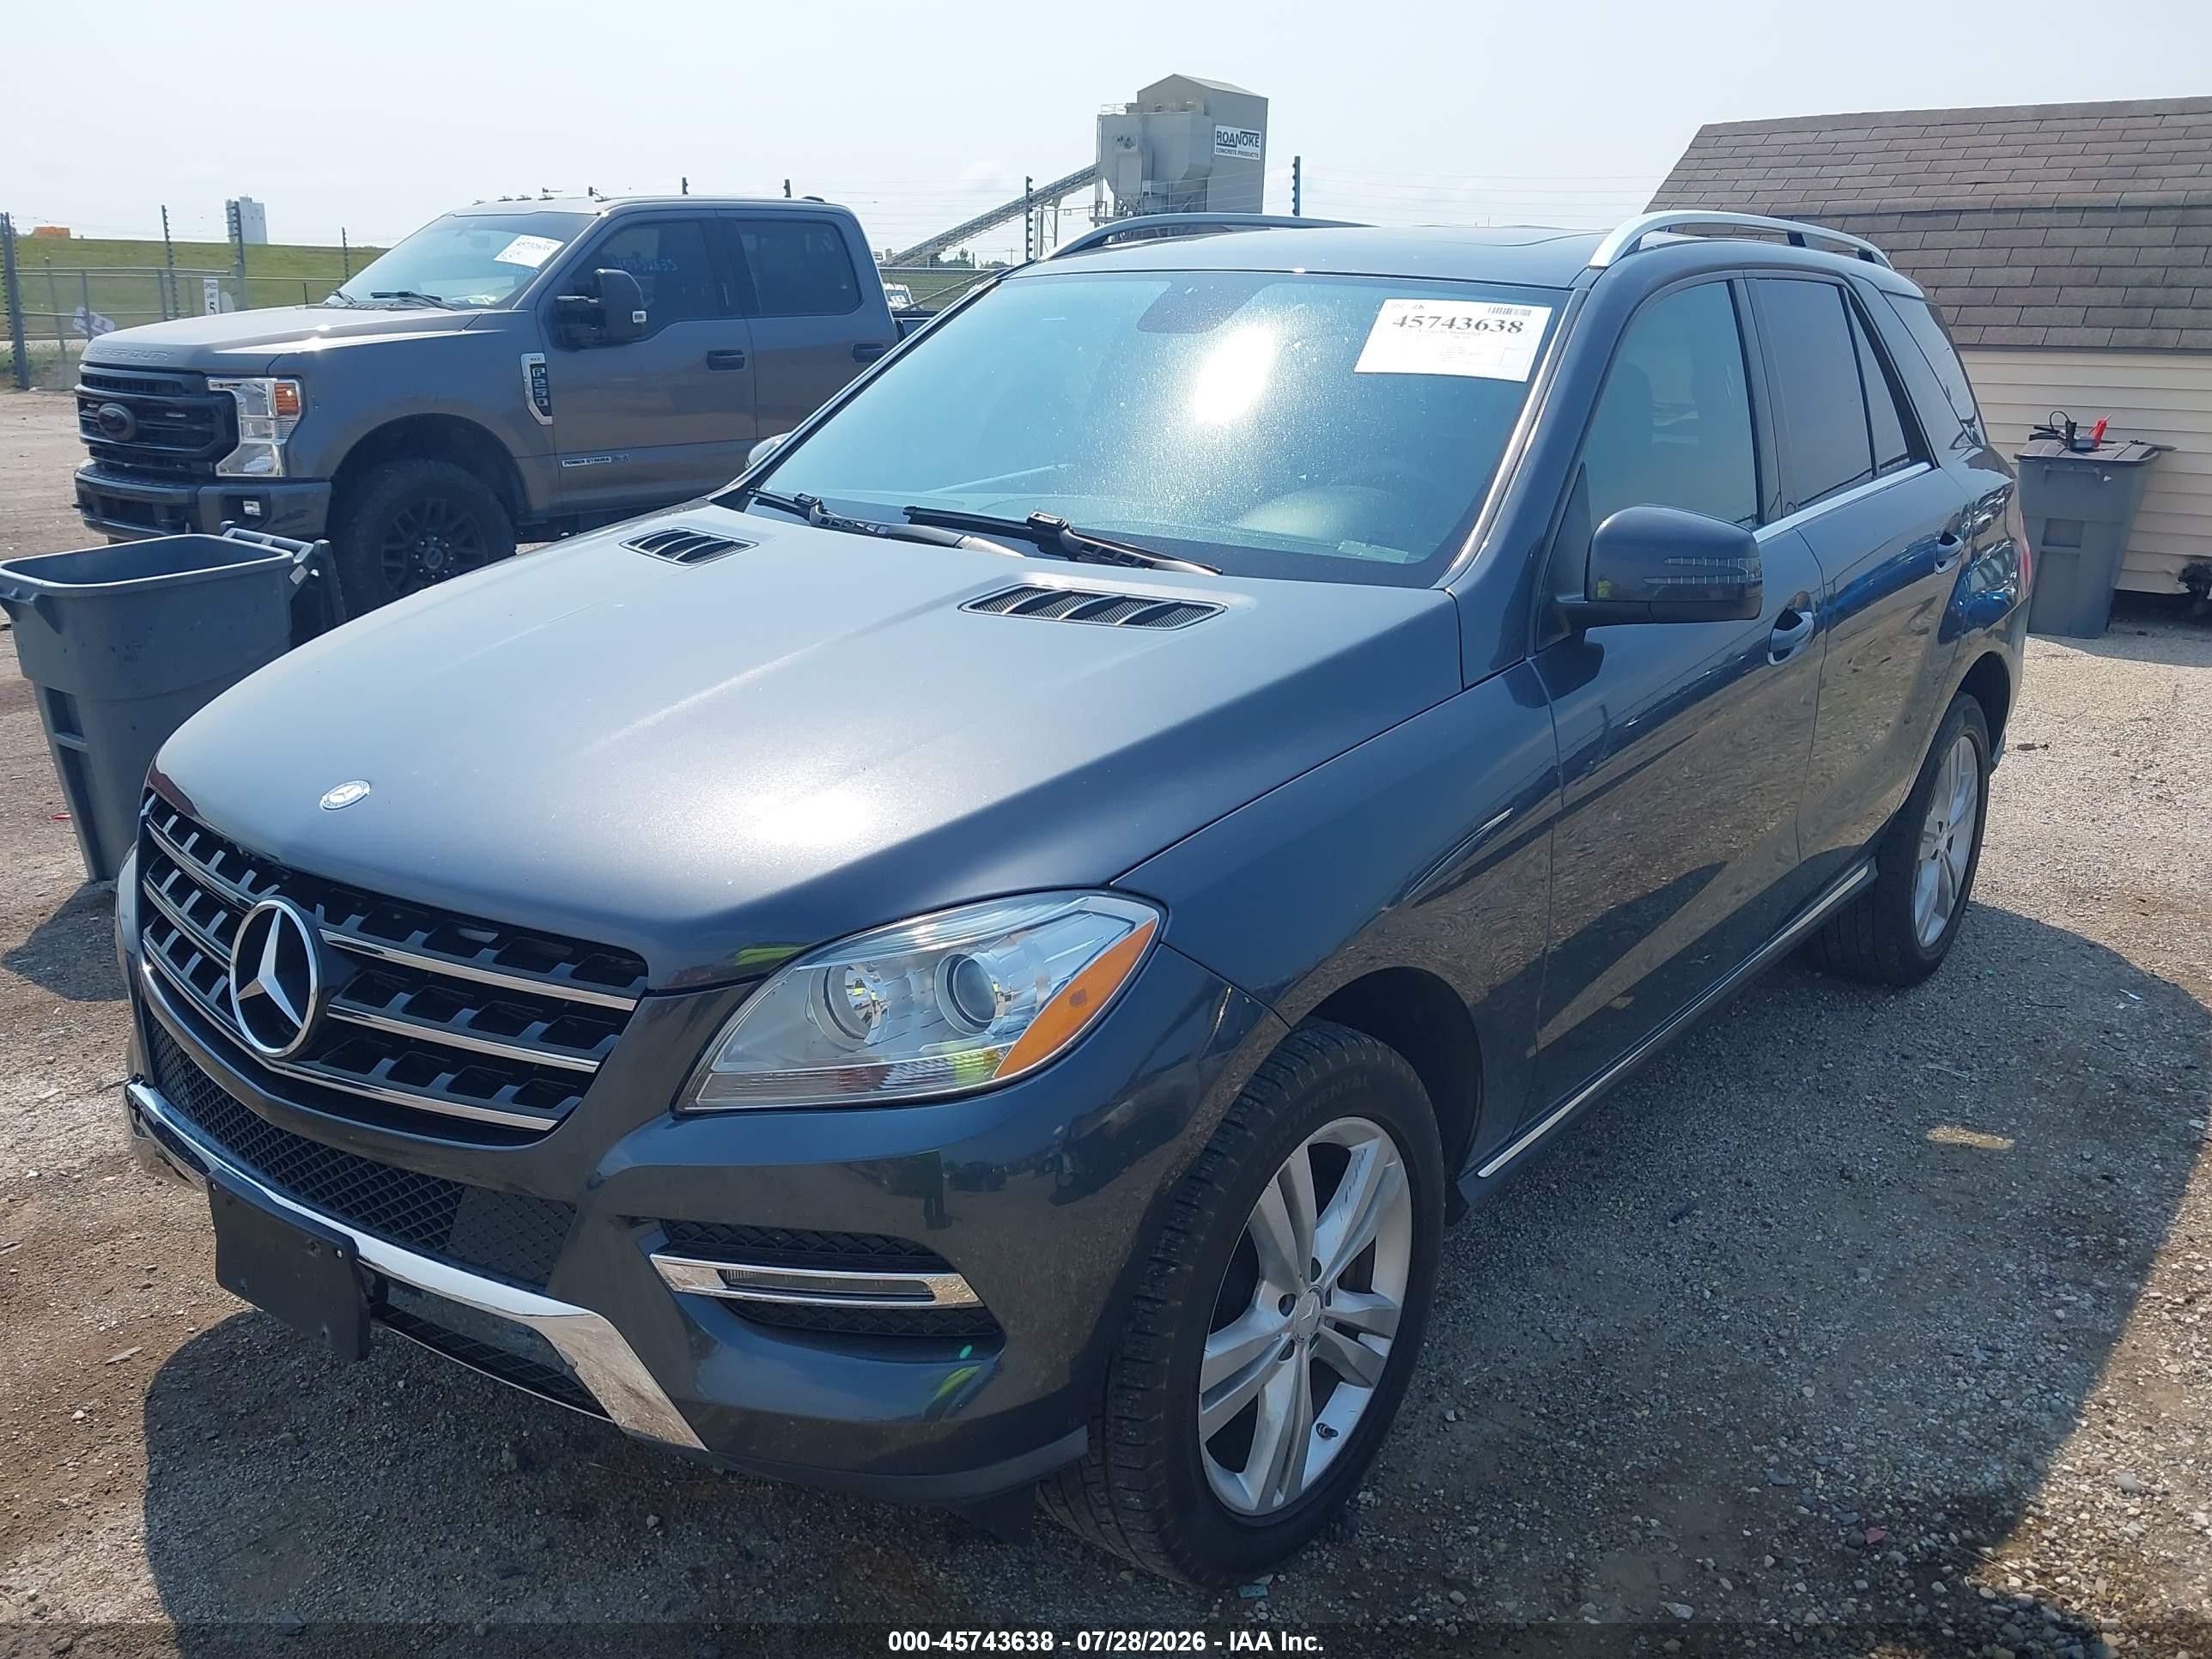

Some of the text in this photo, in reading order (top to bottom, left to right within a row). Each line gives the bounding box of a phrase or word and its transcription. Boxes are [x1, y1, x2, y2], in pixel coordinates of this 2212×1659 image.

[1217, 131, 1260, 148] ROANOKE
[1216, 147, 1237, 155] CONCRETE
[209, 301, 216, 315] 5
[1392, 315, 1524, 334] 45743638
[129, 349, 174, 361] DUTY
